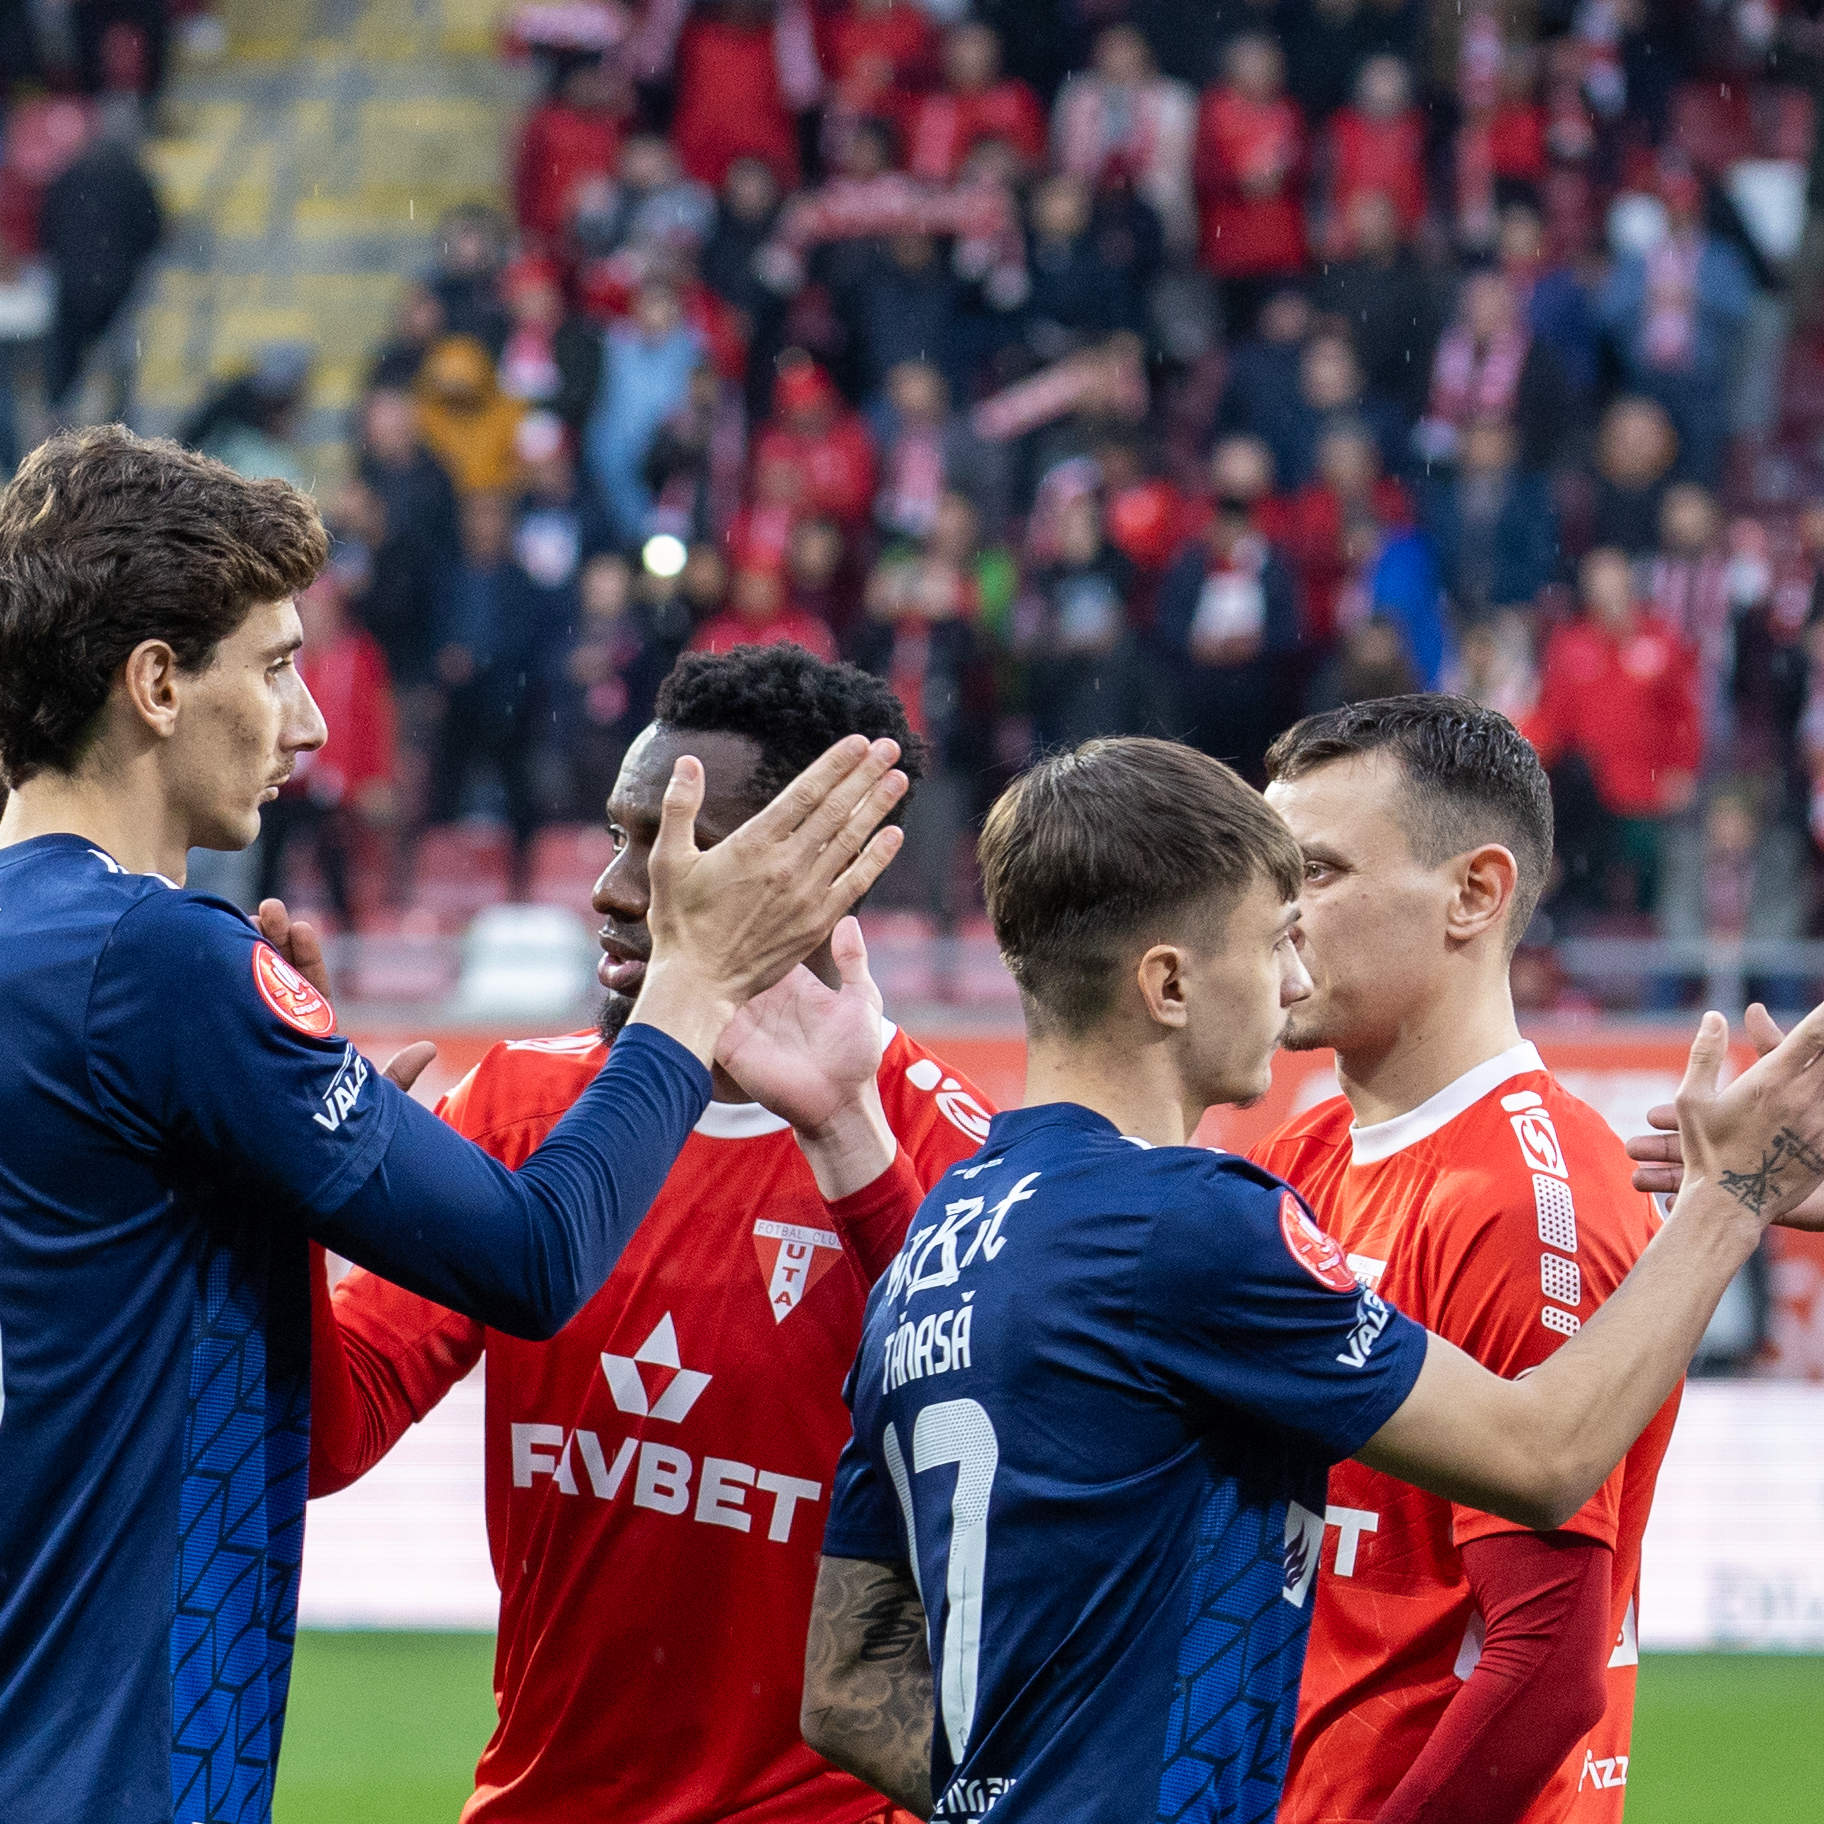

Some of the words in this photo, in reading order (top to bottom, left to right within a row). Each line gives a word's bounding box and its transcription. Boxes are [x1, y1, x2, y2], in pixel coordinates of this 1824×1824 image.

[757, 1222, 803, 1239] FOTBAL
[774, 1244, 806, 1306] UTA
[510, 1422, 821, 1543] FAVBET
